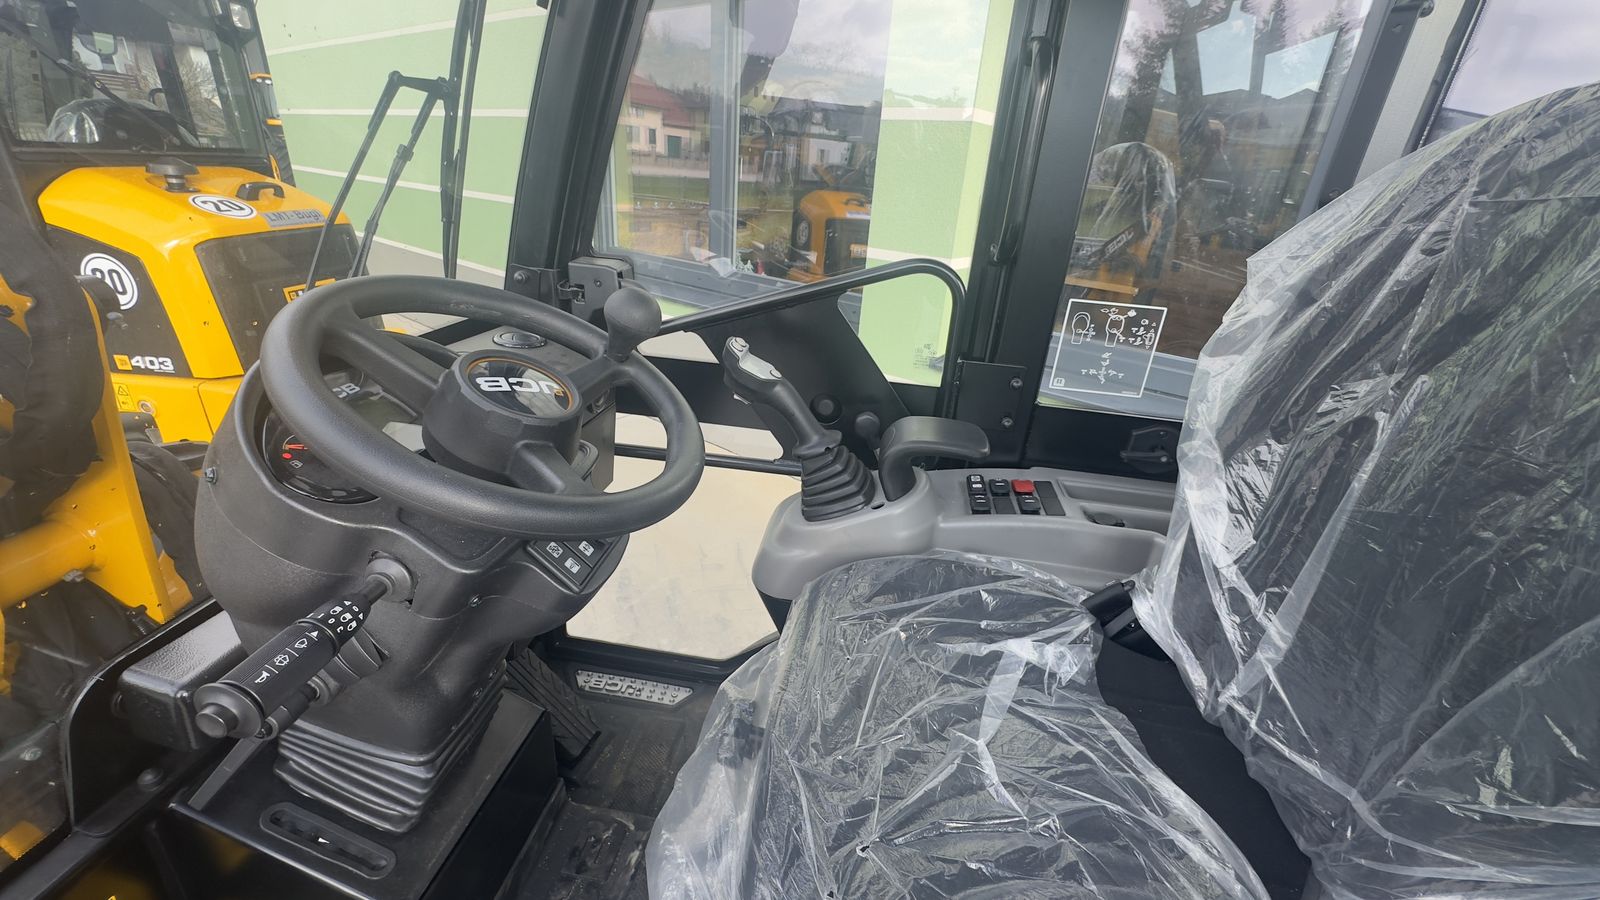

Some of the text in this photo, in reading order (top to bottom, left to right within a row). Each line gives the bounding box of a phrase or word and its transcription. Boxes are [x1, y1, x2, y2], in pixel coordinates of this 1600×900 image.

[200, 199, 245, 213] 20
[131, 355, 175, 371] 403
[332, 382, 361, 399] CB
[475, 376, 561, 394] JCB
[588, 678, 637, 697] JCB
